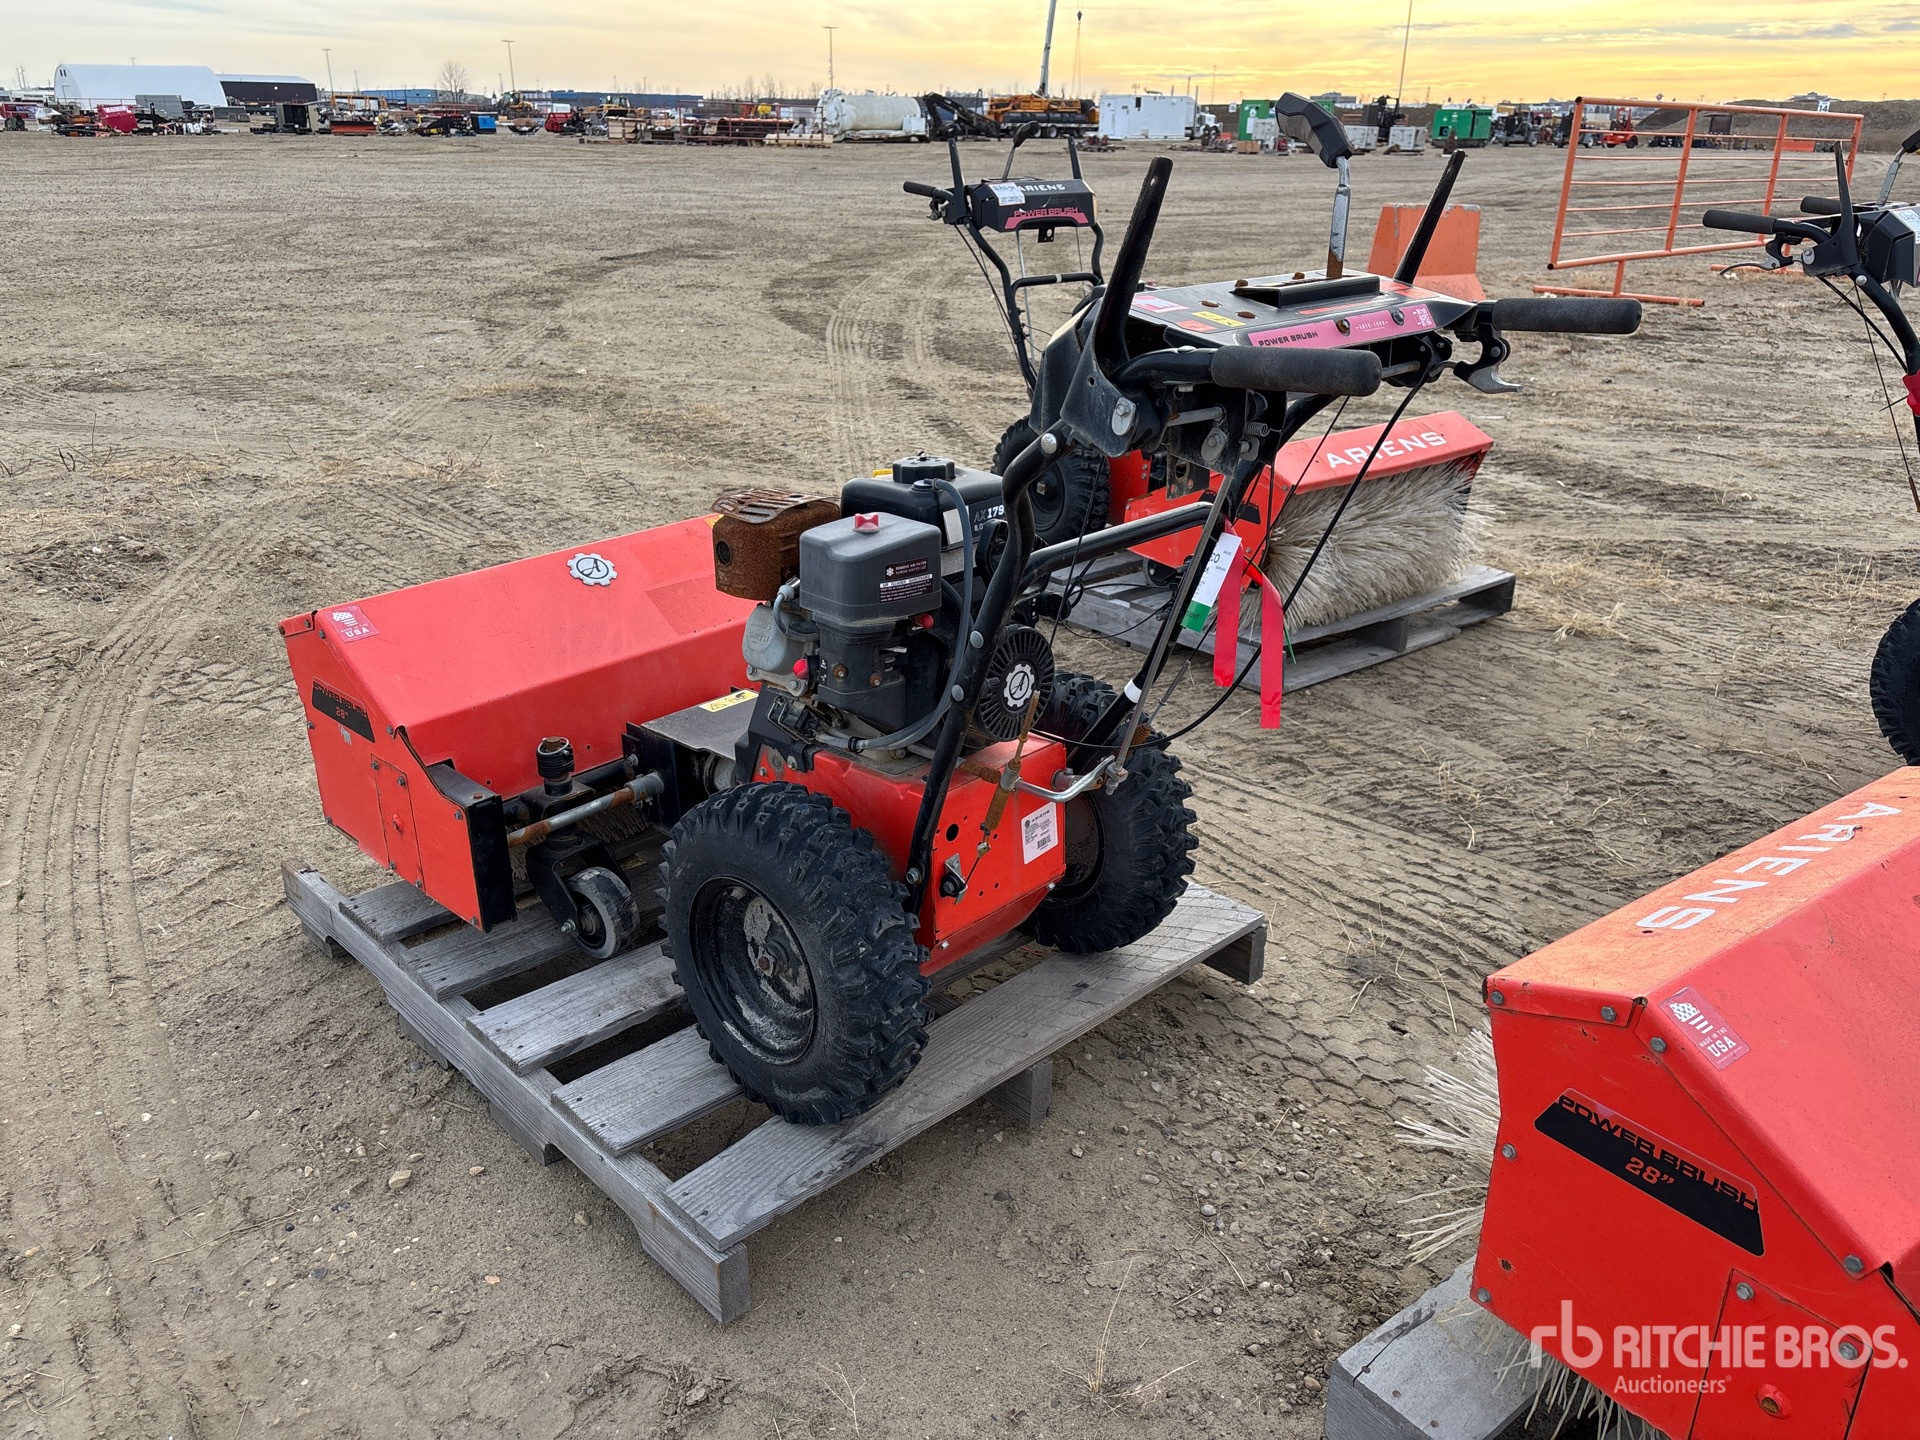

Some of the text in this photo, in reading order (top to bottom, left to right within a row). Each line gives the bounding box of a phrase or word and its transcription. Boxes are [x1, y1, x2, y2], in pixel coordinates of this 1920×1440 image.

[1819, 104, 1828, 113] 14
[1016, 183, 1066, 193] ARIENS
[1013, 207, 1079, 217] POWER BRUSH
[1258, 331, 1319, 347] POWER BRUSH
[1326, 431, 1447, 469] ARIENS
[345, 626, 370, 638] USA
[1635, 802, 1903, 930] ARIENS
[1699, 1026, 1728, 1048] MADE IN THE
[1707, 1035, 1737, 1058] USA
[1558, 1095, 1760, 1214] POWER BRUSH
